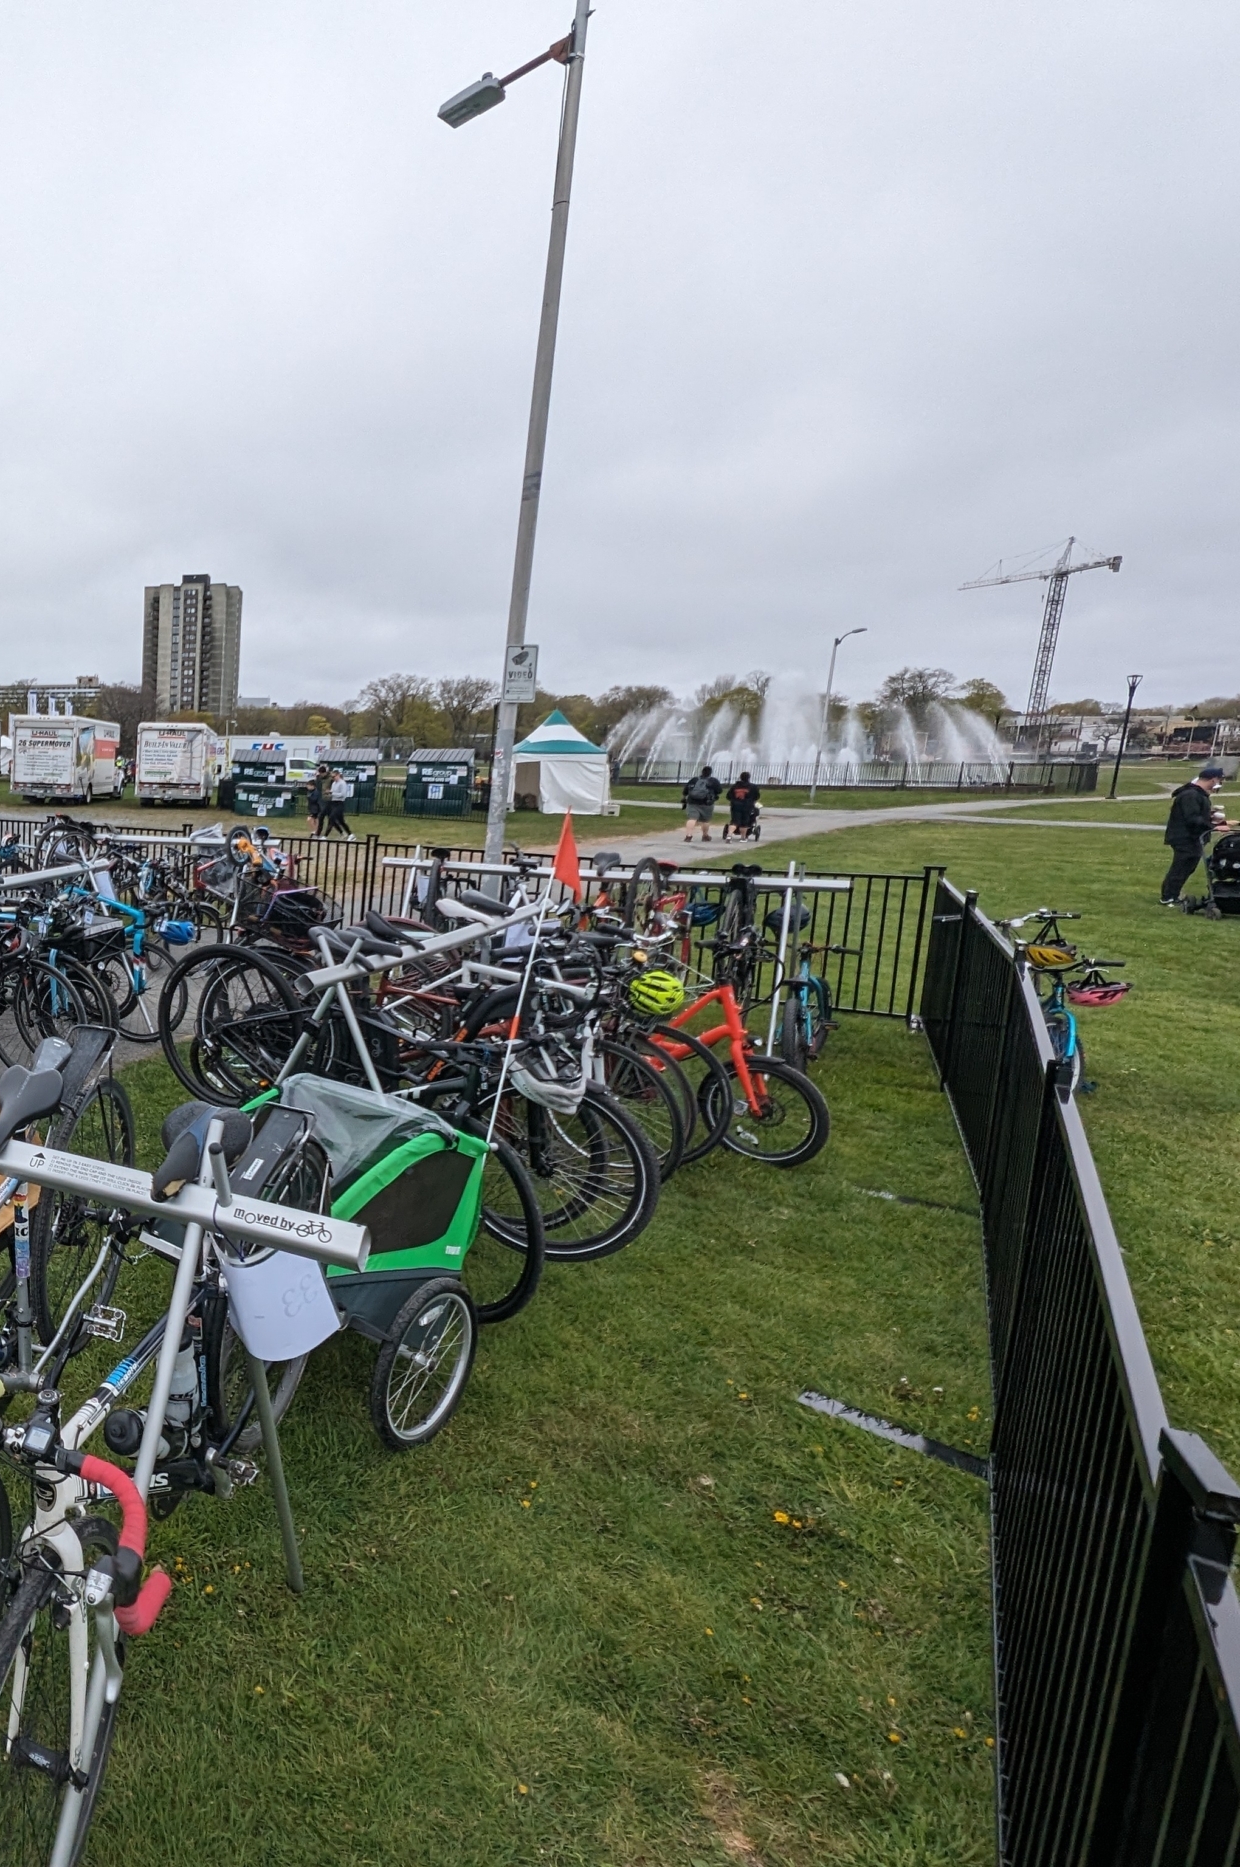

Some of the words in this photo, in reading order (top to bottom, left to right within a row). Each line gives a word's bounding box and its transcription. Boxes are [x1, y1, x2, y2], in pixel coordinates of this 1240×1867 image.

[508, 670, 533, 679] VIDEO
[28, 740, 71, 748] SUPERMOVER
[29, 1158, 45, 1169] UP
[233, 1208, 279, 1226] moved
[280, 1217, 296, 1231] by
